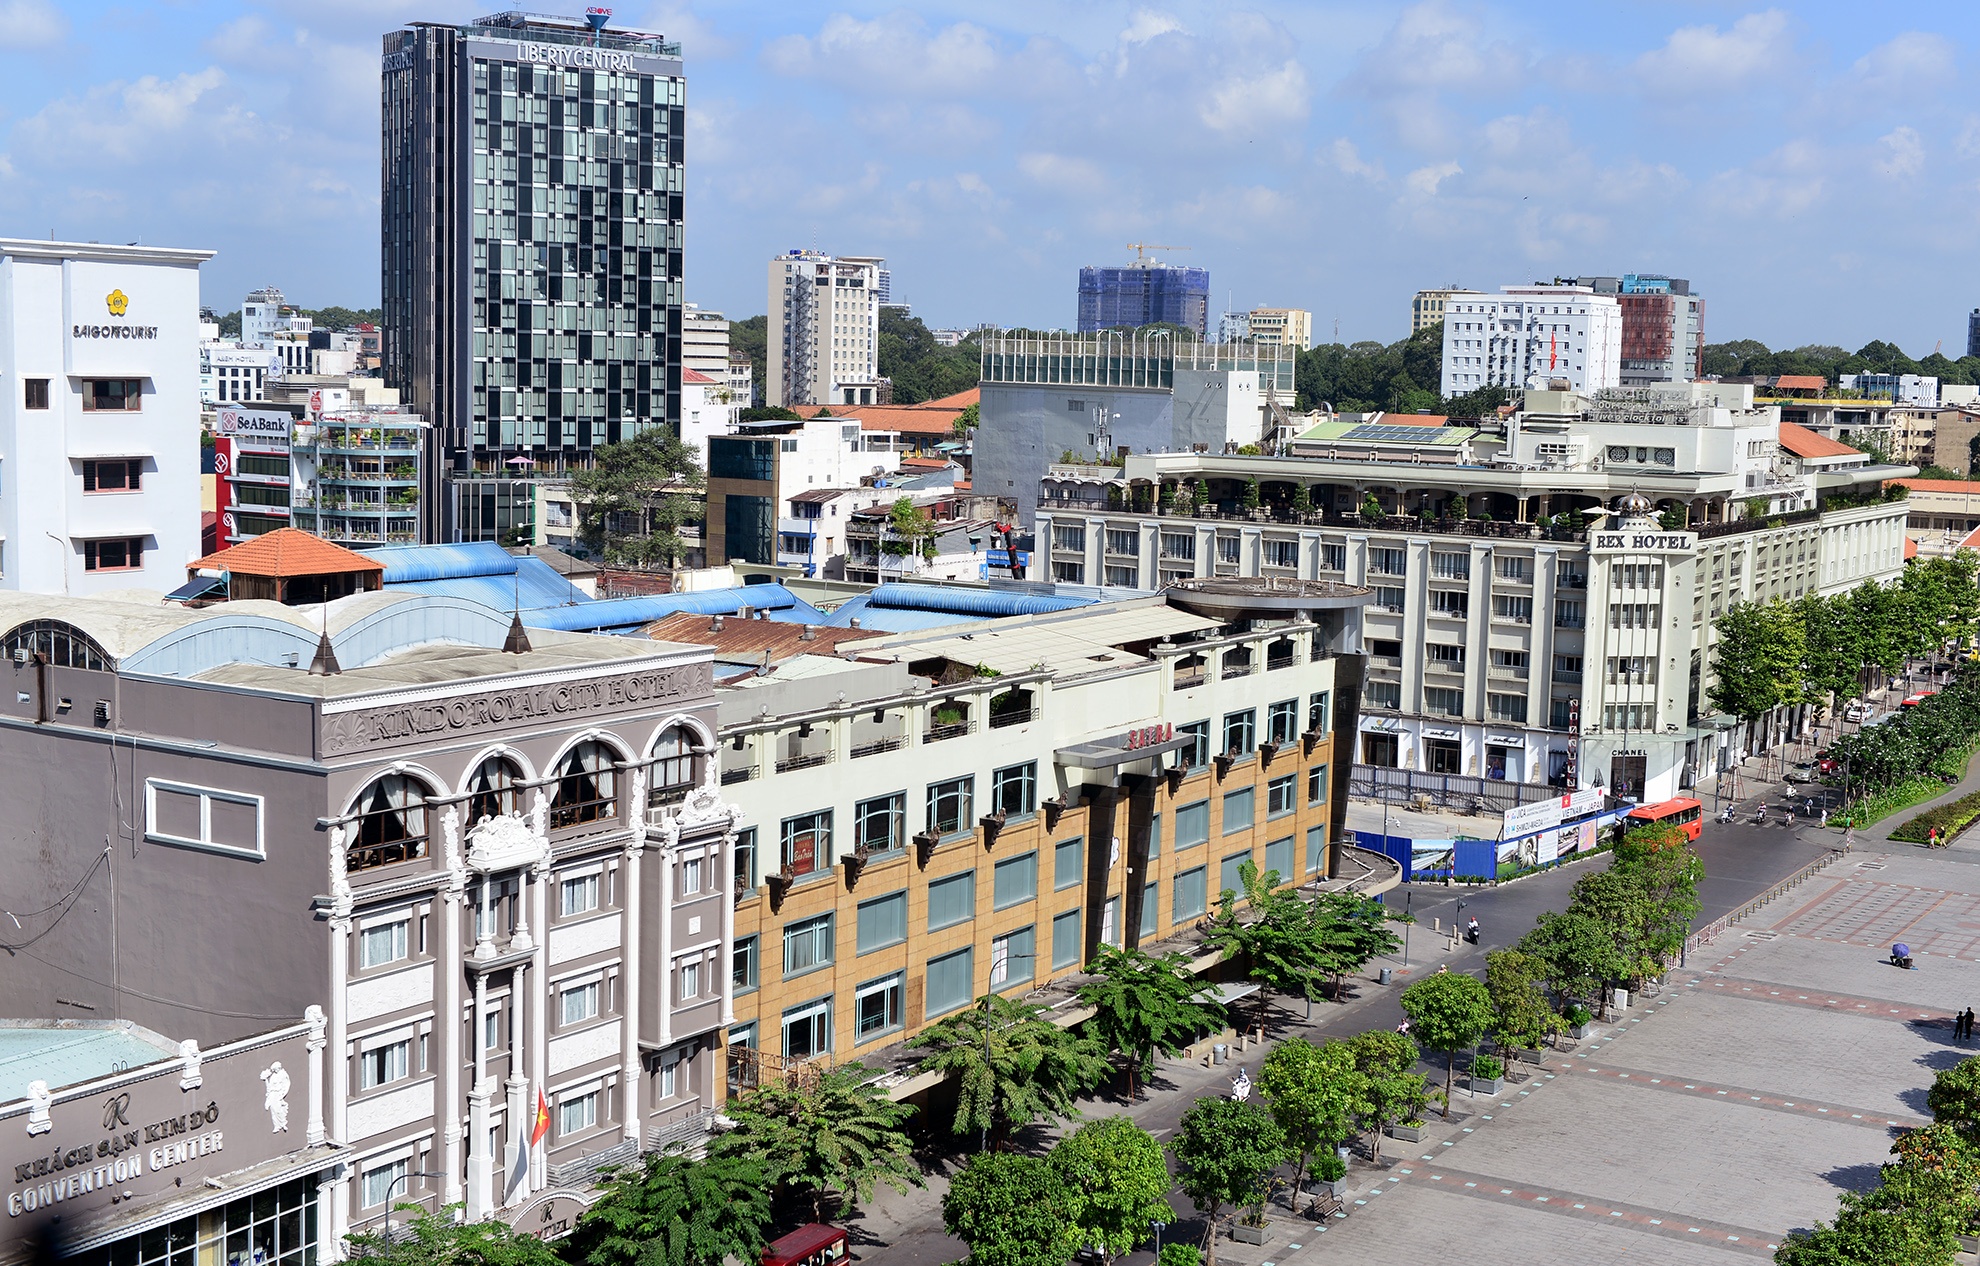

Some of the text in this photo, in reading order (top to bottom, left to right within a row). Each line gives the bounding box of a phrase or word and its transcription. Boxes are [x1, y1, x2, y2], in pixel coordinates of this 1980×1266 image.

[517, 44, 637, 72] LIBERTY CENTRAL
[73, 325, 158, 340] SAIGONTOURIST
[1597, 387, 1634, 401] REX
[237, 416, 285, 432] SeABank
[1596, 534, 1692, 550] REX HOTEL
[470, 691, 551, 724] ROYAL
[550, 682, 602, 714] CITY
[606, 672, 680, 706] HOTEL
[1128, 722, 1173, 750] SATRA
[15, 1145, 94, 1184] KHÁCH
[97, 1129, 140, 1157] SẠN
[144, 1114, 188, 1144] KIM
[8, 1129, 225, 1218] CONVENTION CENTER
